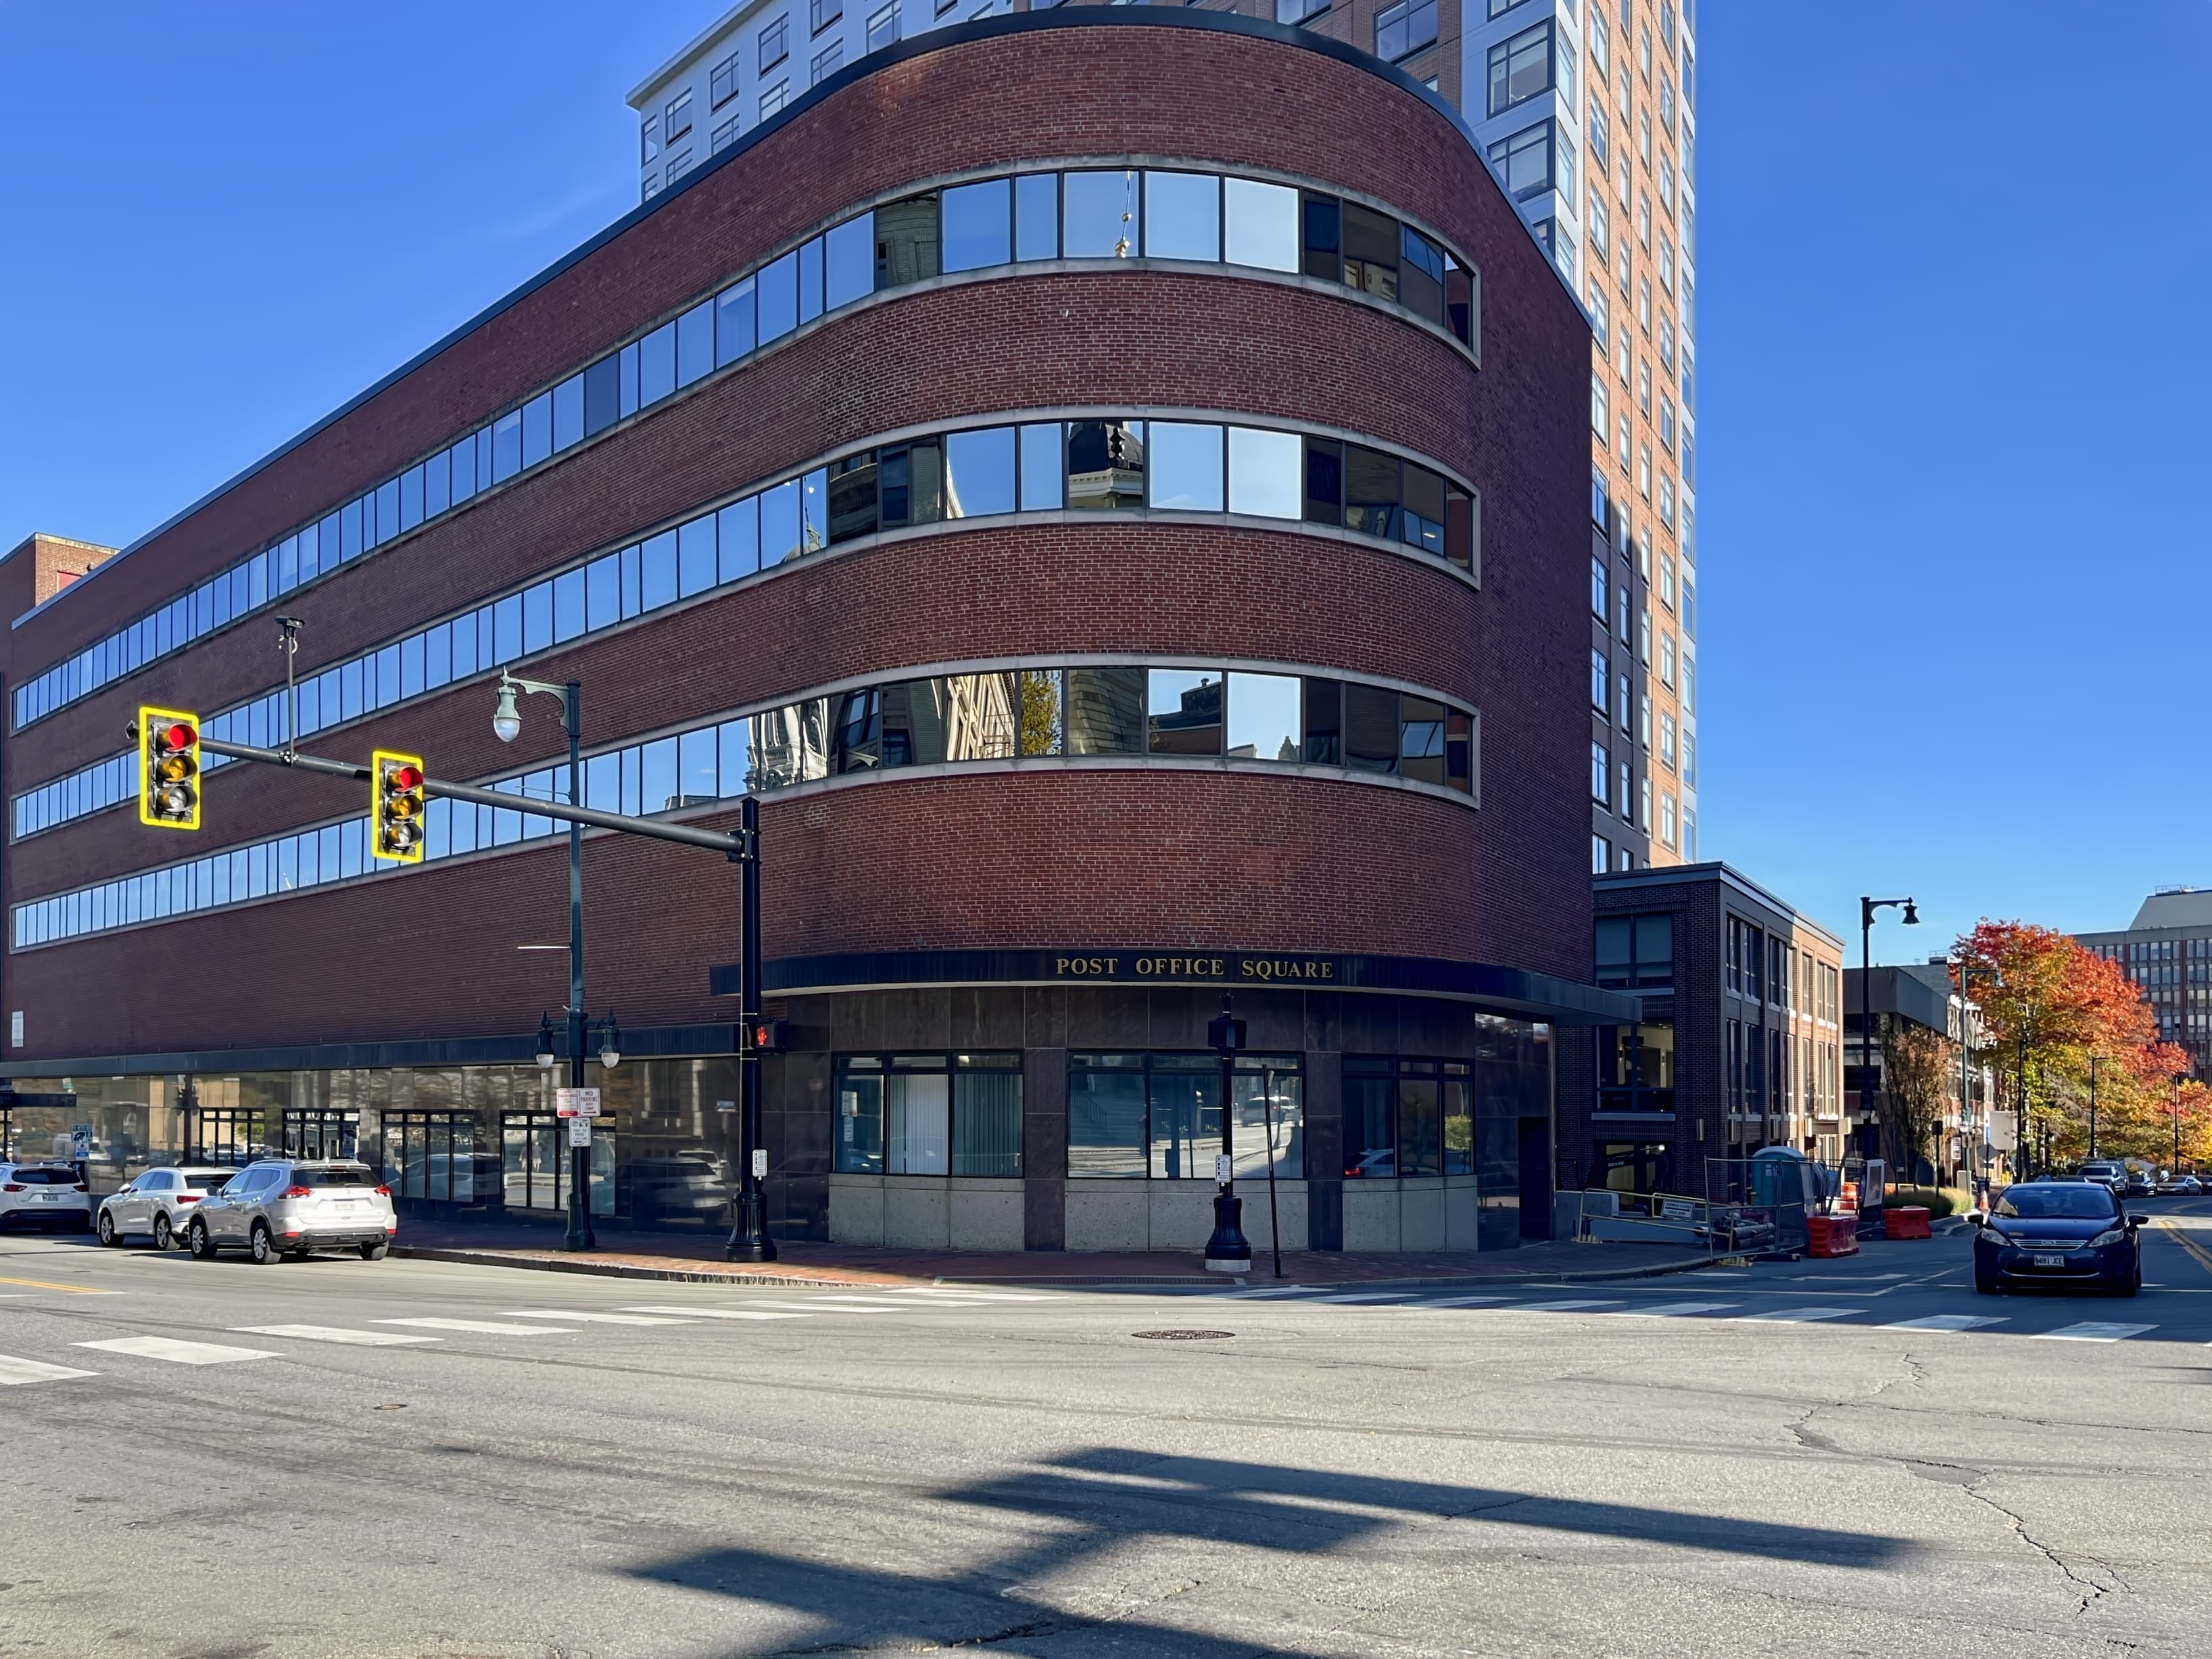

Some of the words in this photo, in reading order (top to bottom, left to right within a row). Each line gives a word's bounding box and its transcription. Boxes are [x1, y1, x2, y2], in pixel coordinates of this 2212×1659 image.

[1056, 958, 1118, 975] POST
[1136, 958, 1224, 976] OFFICE
[1242, 960, 1333, 980] SQUARE
